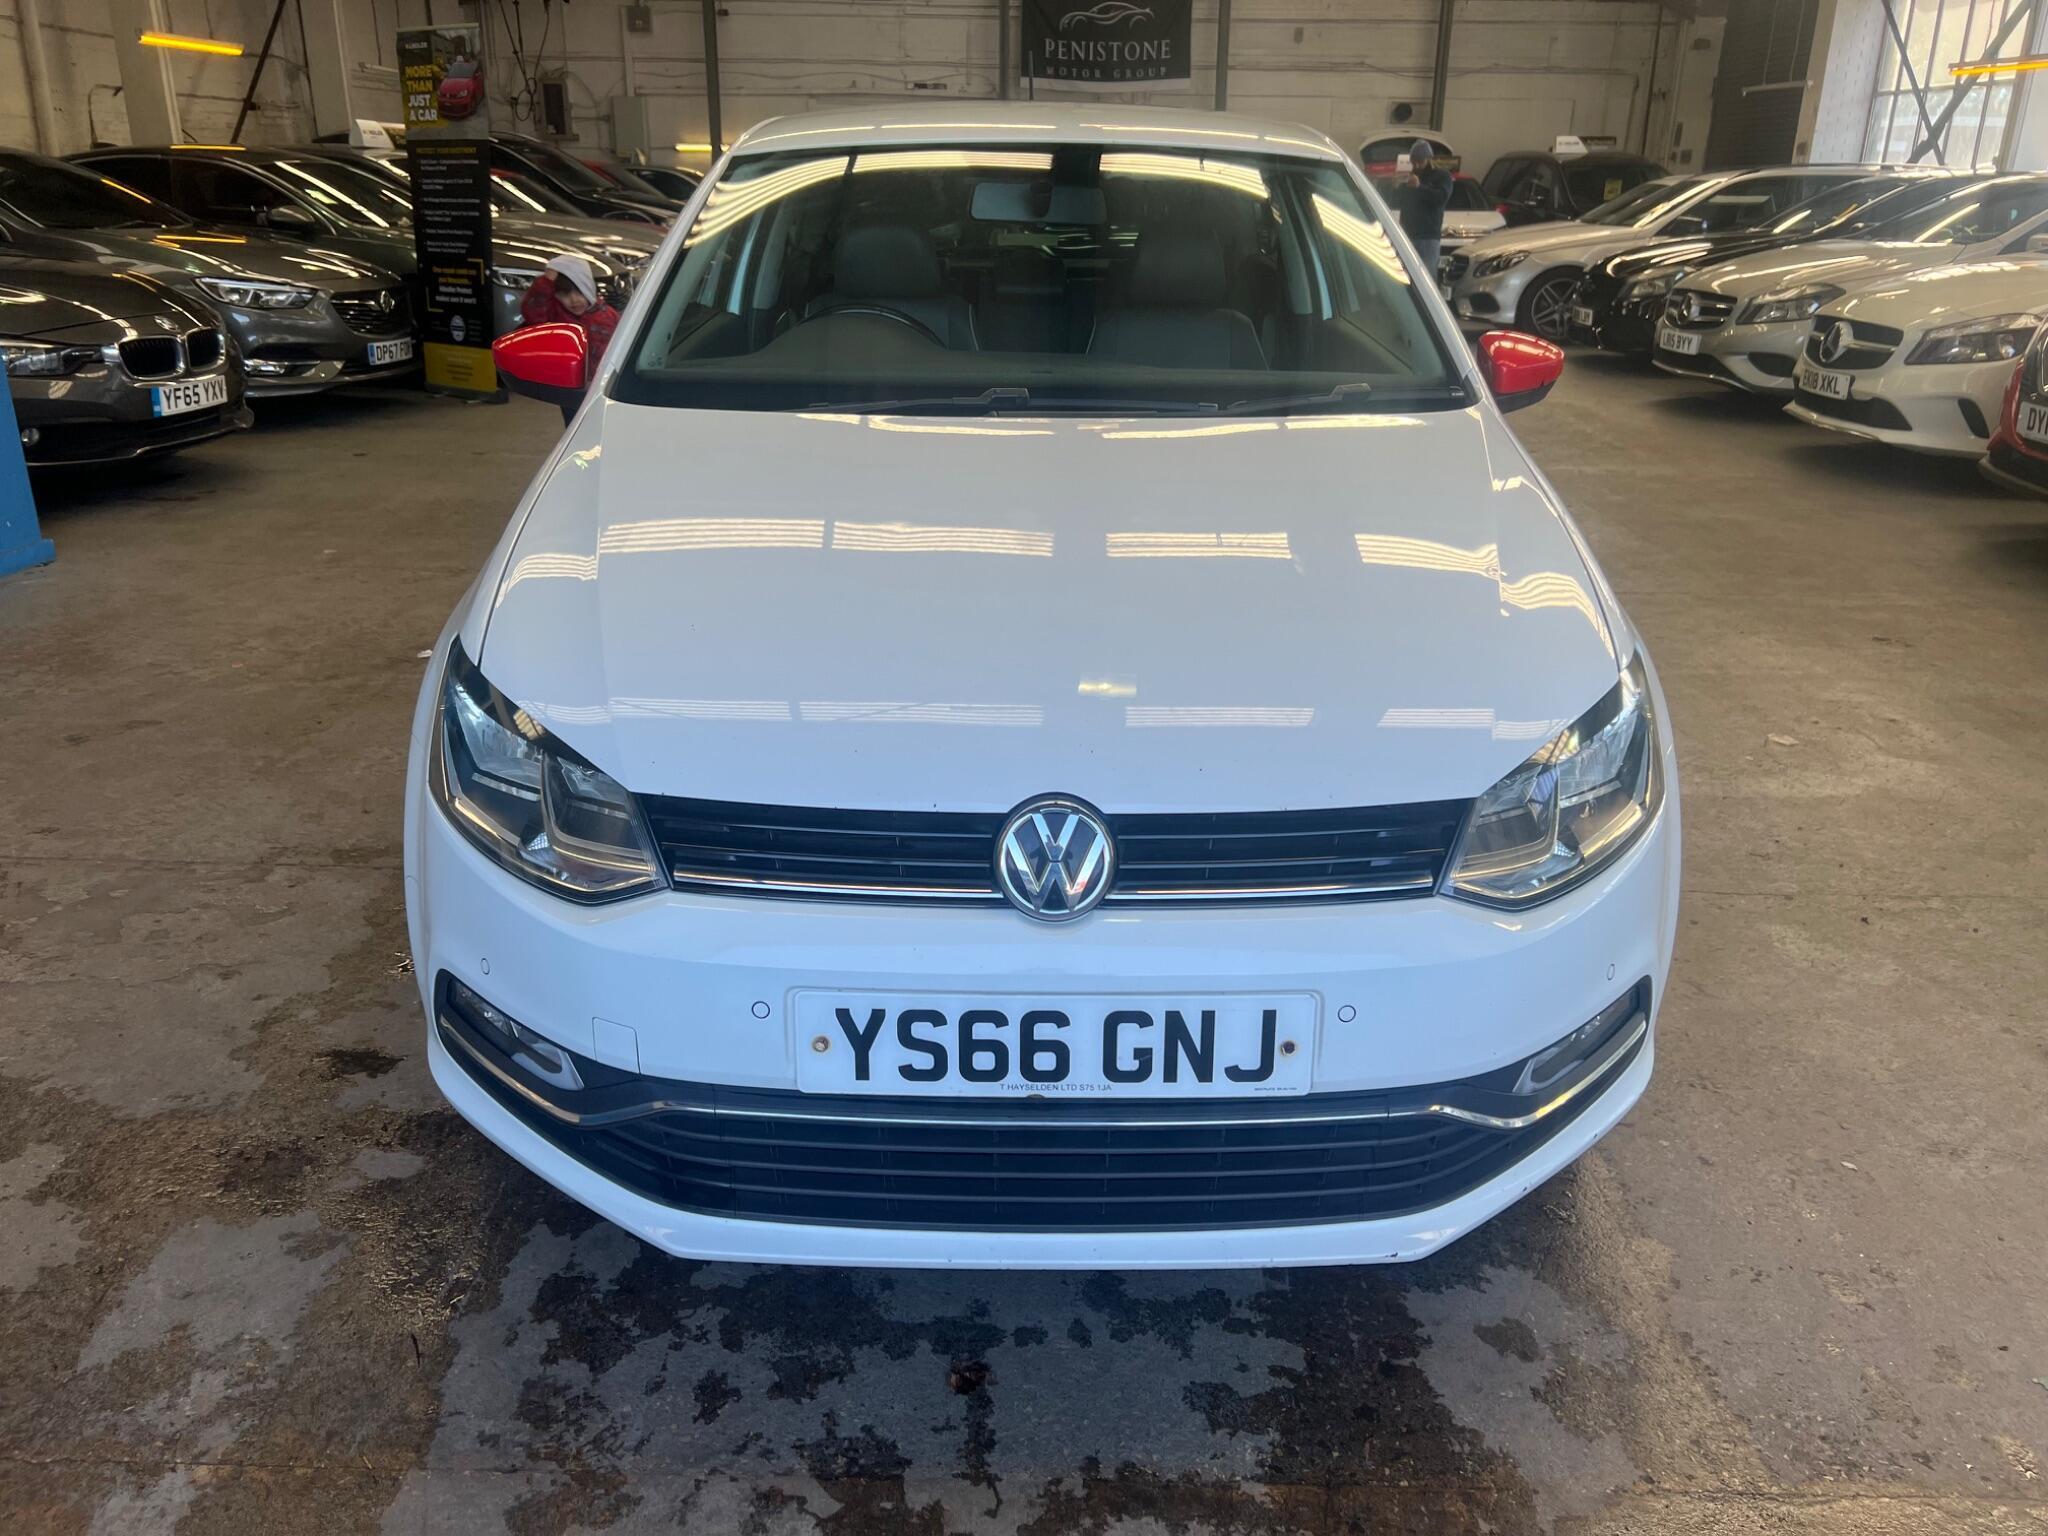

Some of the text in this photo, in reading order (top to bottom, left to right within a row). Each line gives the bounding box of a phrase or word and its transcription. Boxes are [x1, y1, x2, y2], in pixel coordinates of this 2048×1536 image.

[1044, 38, 1172, 61] PENISTONE
[405, 64, 433, 78] MORE
[1046, 66, 1168, 79] MOTOR GROUP
[407, 79, 434, 93] THAN
[408, 93, 432, 107] JUST
[409, 108, 438, 121] A CAR
[376, 342, 399, 361] DP67
[1819, 373, 1840, 396] XKL
[163, 380, 224, 411] YF65 YXV
[835, 1007, 1277, 1083] YS66 GNJ
[1007, 1083, 1058, 1091] HAYSELDEN
[1060, 1083, 1077, 1091] LTD
[1079, 1083, 1095, 1091] S75
[1098, 1083, 1112, 1091] 1JA
